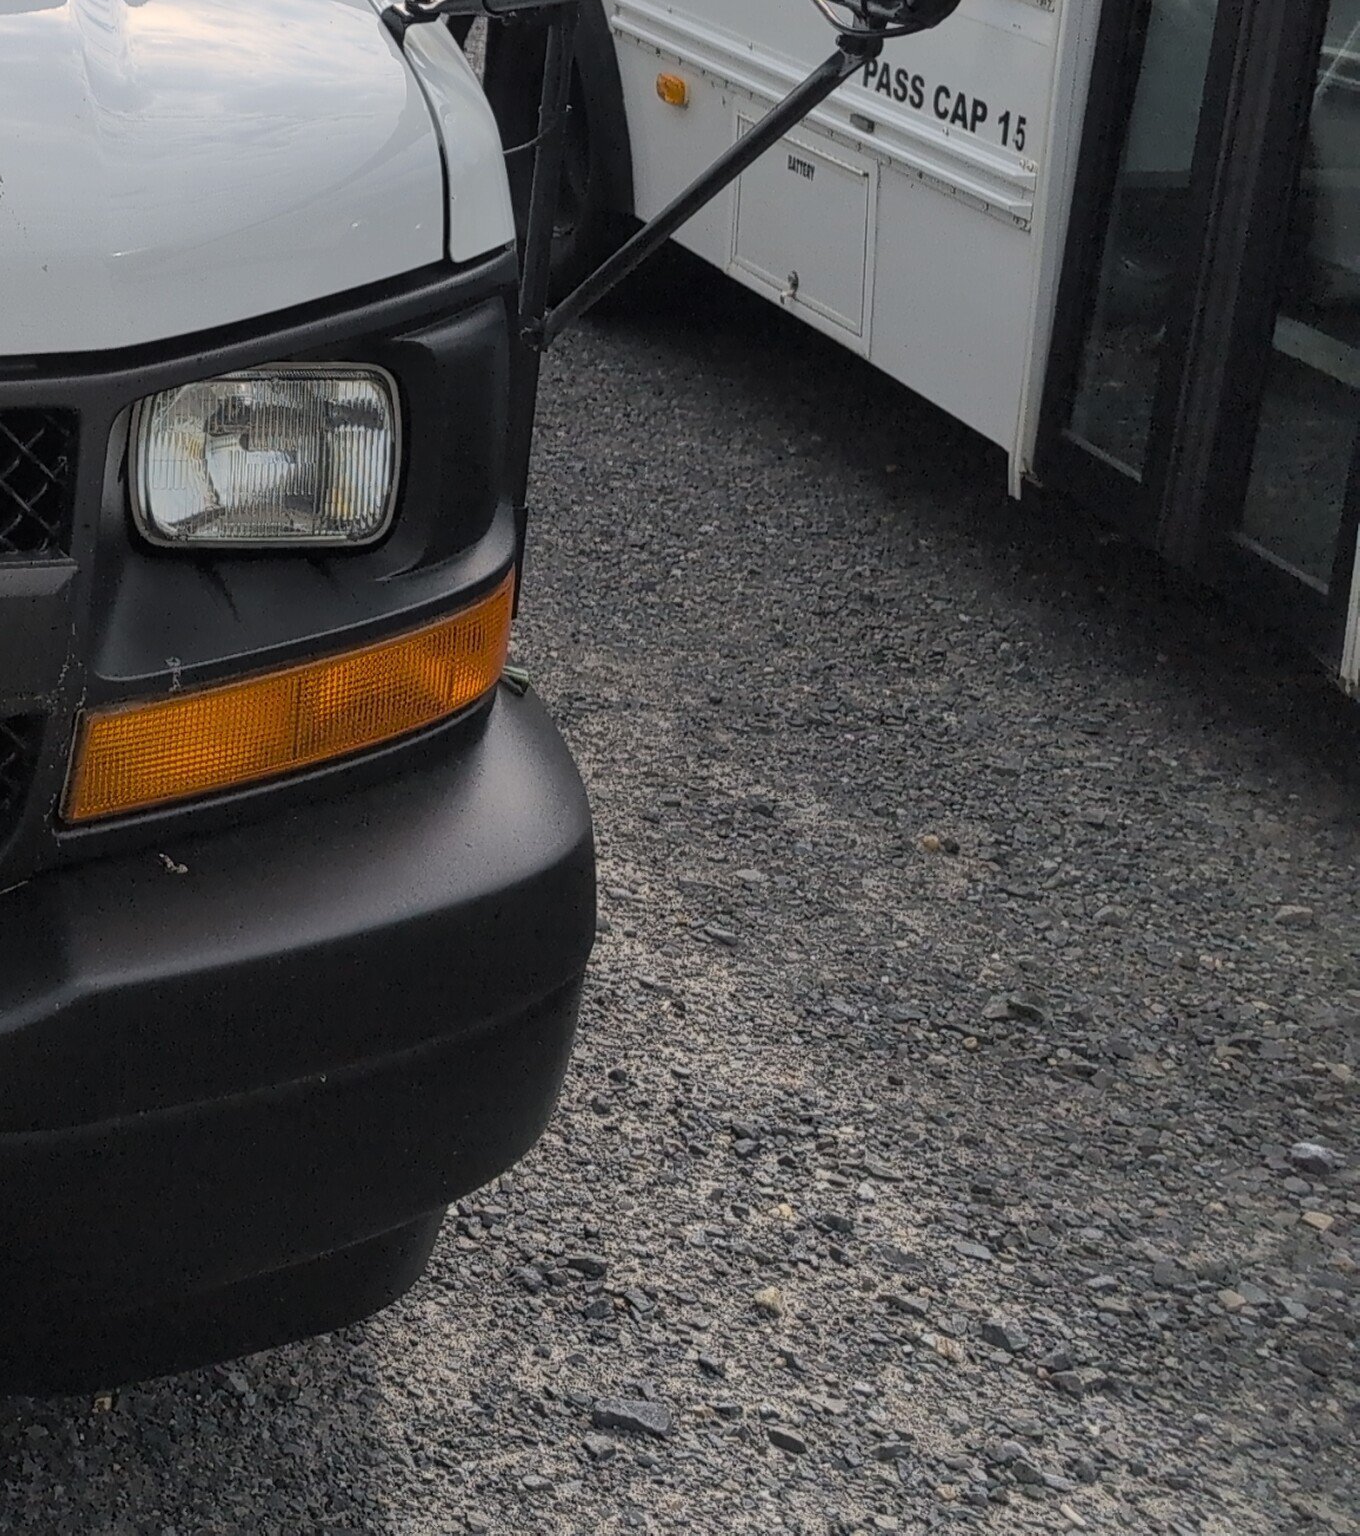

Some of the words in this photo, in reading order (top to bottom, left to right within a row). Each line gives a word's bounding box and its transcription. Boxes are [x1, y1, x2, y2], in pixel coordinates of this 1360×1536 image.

[863, 57, 926, 110] PASS
[933, 84, 989, 134] CAP
[998, 110, 1028, 152] 15
[787, 154, 816, 182] BATTERY
